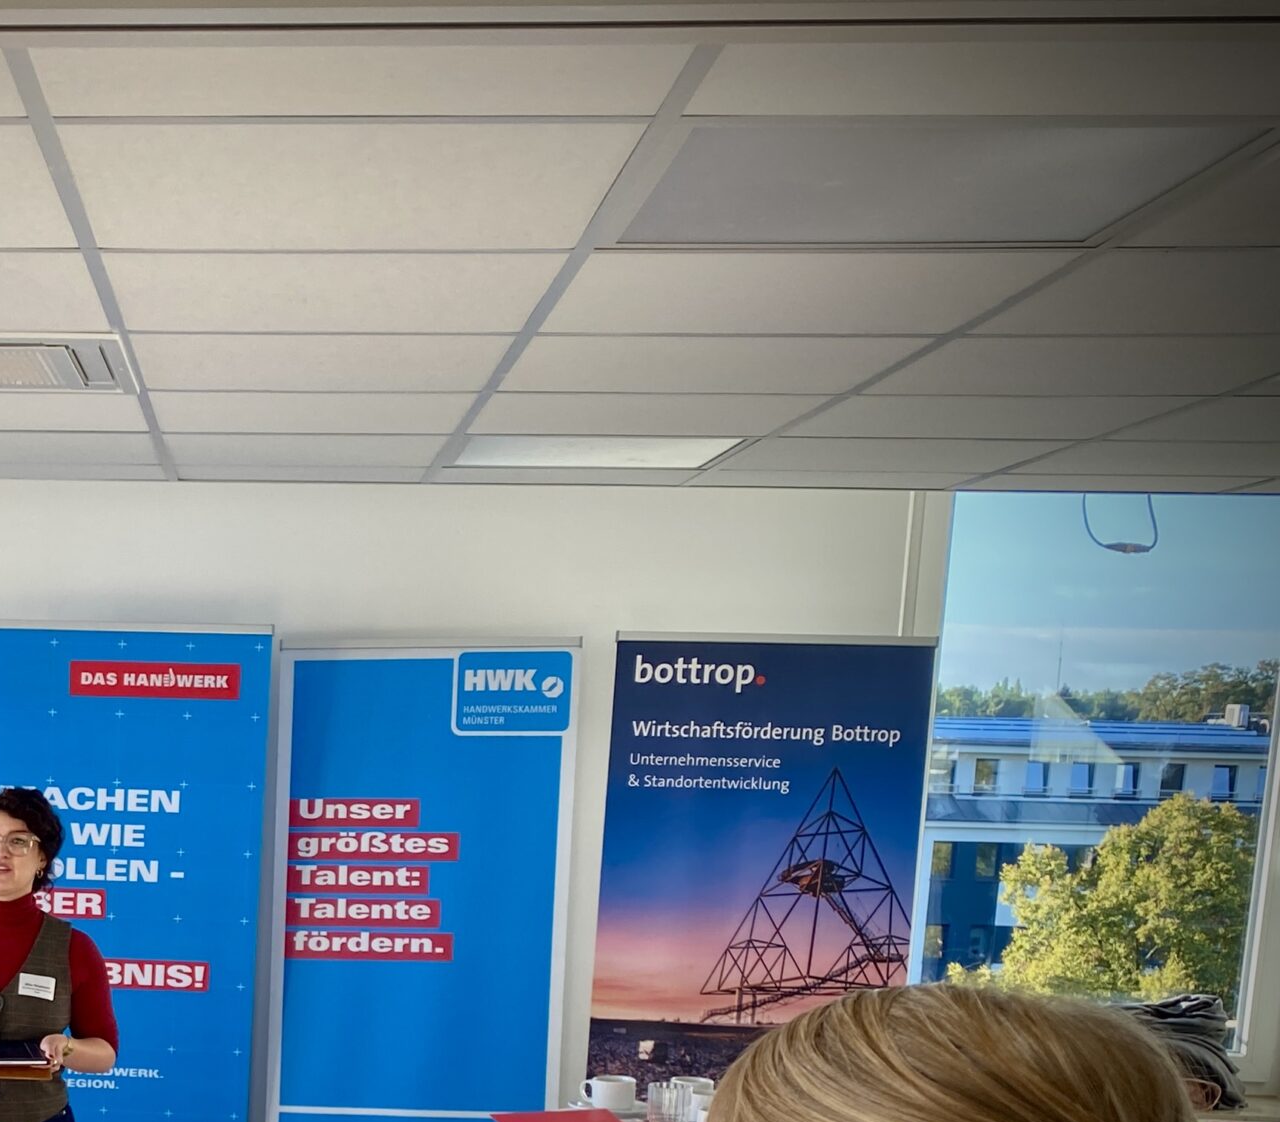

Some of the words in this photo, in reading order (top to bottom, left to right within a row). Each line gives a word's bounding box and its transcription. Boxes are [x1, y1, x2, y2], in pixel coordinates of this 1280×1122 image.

[80, 672, 118, 686] DAS
[124, 668, 228, 688] HANDWERK
[464, 669, 537, 691] HWK
[633, 655, 766, 693] bottrop.
[463, 705, 557, 714] HANDWERKSKAMMER
[463, 715, 504, 725] MÜNSTER
[632, 721, 825, 745] Wirtschaftsförderung
[832, 725, 901, 747] Bottrop
[630, 753, 781, 768] Unternehmensservice
[628, 775, 640, 788] &
[644, 776, 790, 794] Standortentwicklung
[0, 785, 180, 813] ACHEN
[298, 798, 411, 820] Unser
[70, 823, 145, 847] WIE
[297, 831, 449, 857] größtes
[296, 865, 420, 886] Talent:
[33, 892, 102, 915] BER
[294, 898, 431, 920] Talente
[293, 930, 444, 953] fördern.
[105, 962, 205, 988] BNIS!
[67, 1079, 119, 1089] EGION.
